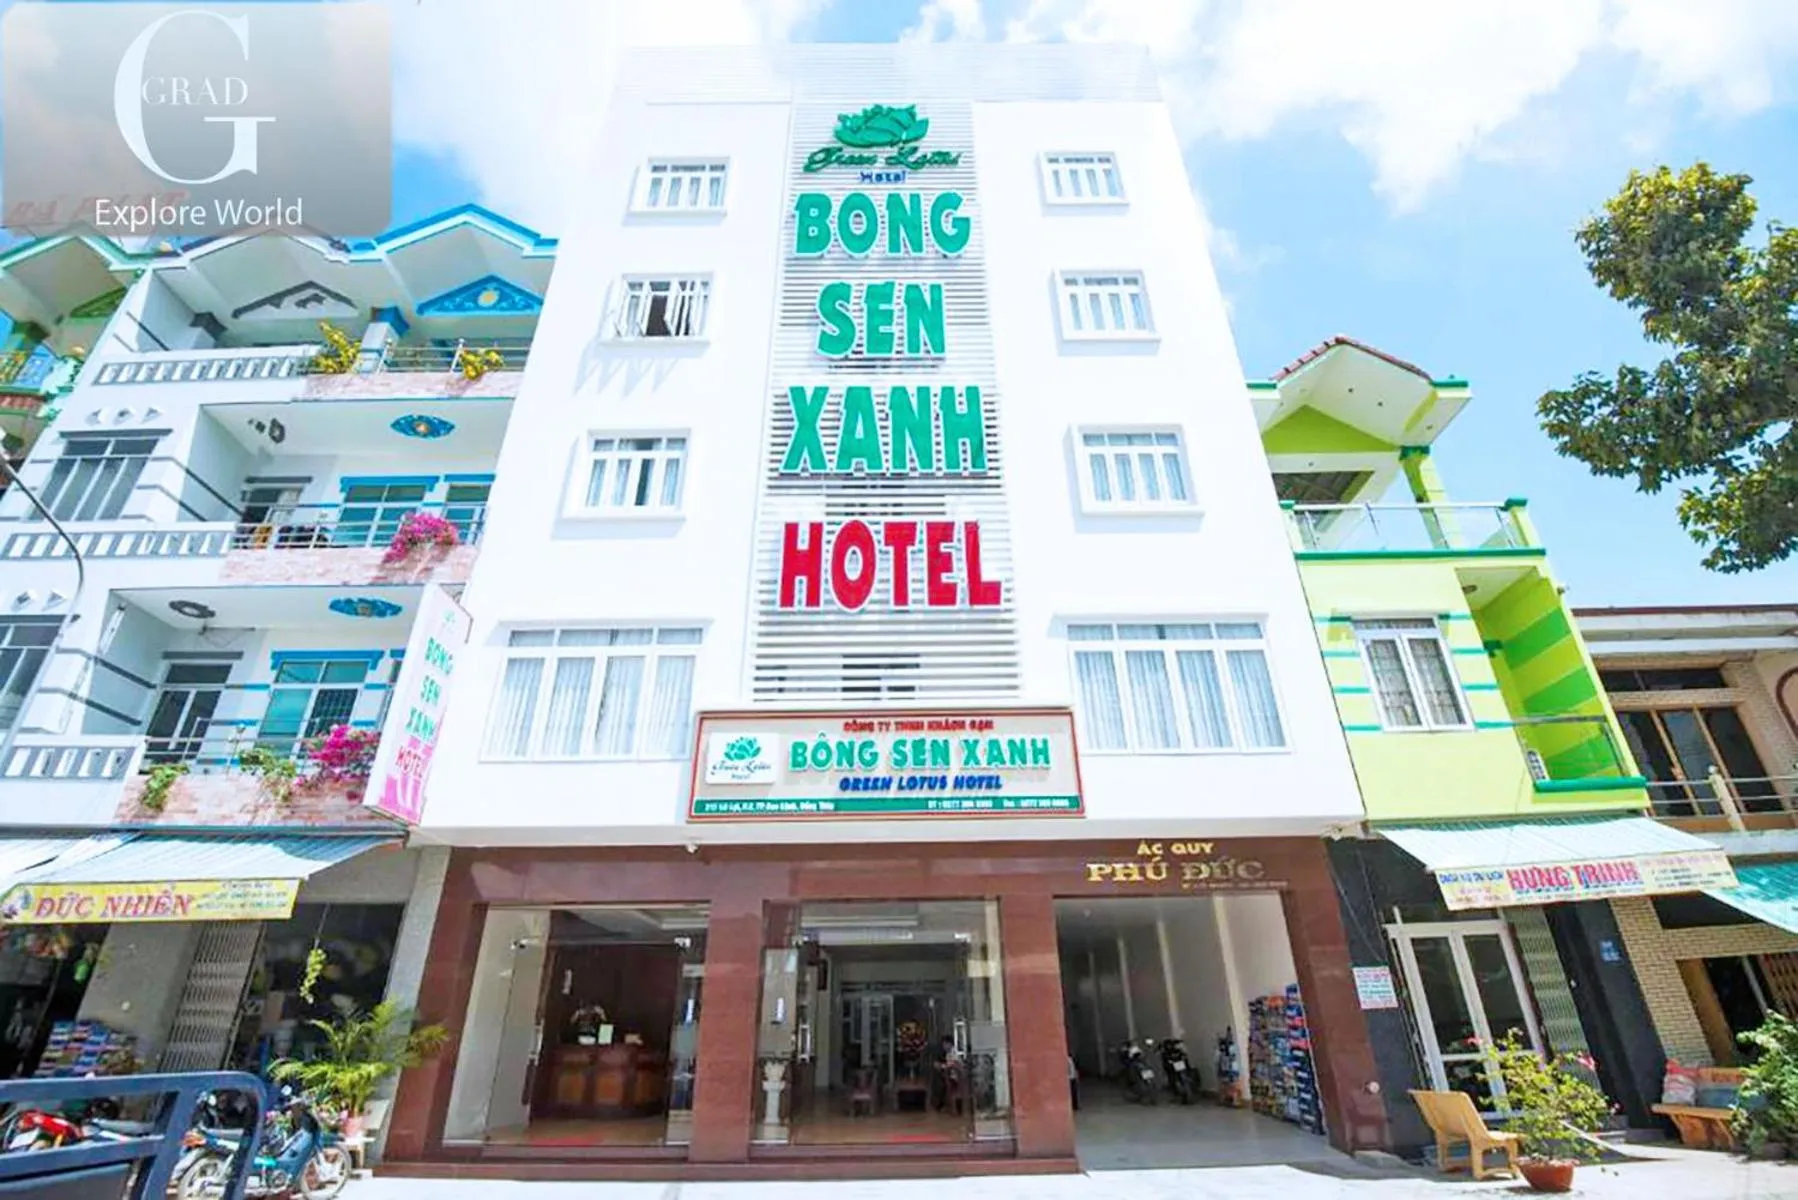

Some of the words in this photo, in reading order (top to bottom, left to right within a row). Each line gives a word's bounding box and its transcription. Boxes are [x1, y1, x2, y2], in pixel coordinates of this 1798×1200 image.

[860, 171, 907, 184] Hotel
[794, 191, 972, 255] BONG
[816, 281, 947, 356] SEN
[782, 386, 987, 473] XANH
[778, 519, 1002, 609] HOTEL
[844, 718, 874, 733] CÔNG
[877, 720, 891, 732] TY
[395, 745, 423, 779] HOTEL
[790, 732, 880, 769] BÔNG
[890, 738, 951, 769] SEN
[962, 737, 1052, 769] XANH
[839, 776, 892, 792] GREEN
[897, 775, 948, 791] LOTUS
[952, 774, 1003, 791] HOTEL
[1171, 842, 1215, 855] QUY
[1086, 856, 1169, 882] PHÚ
[1180, 856, 1265, 881] ĐỨC
